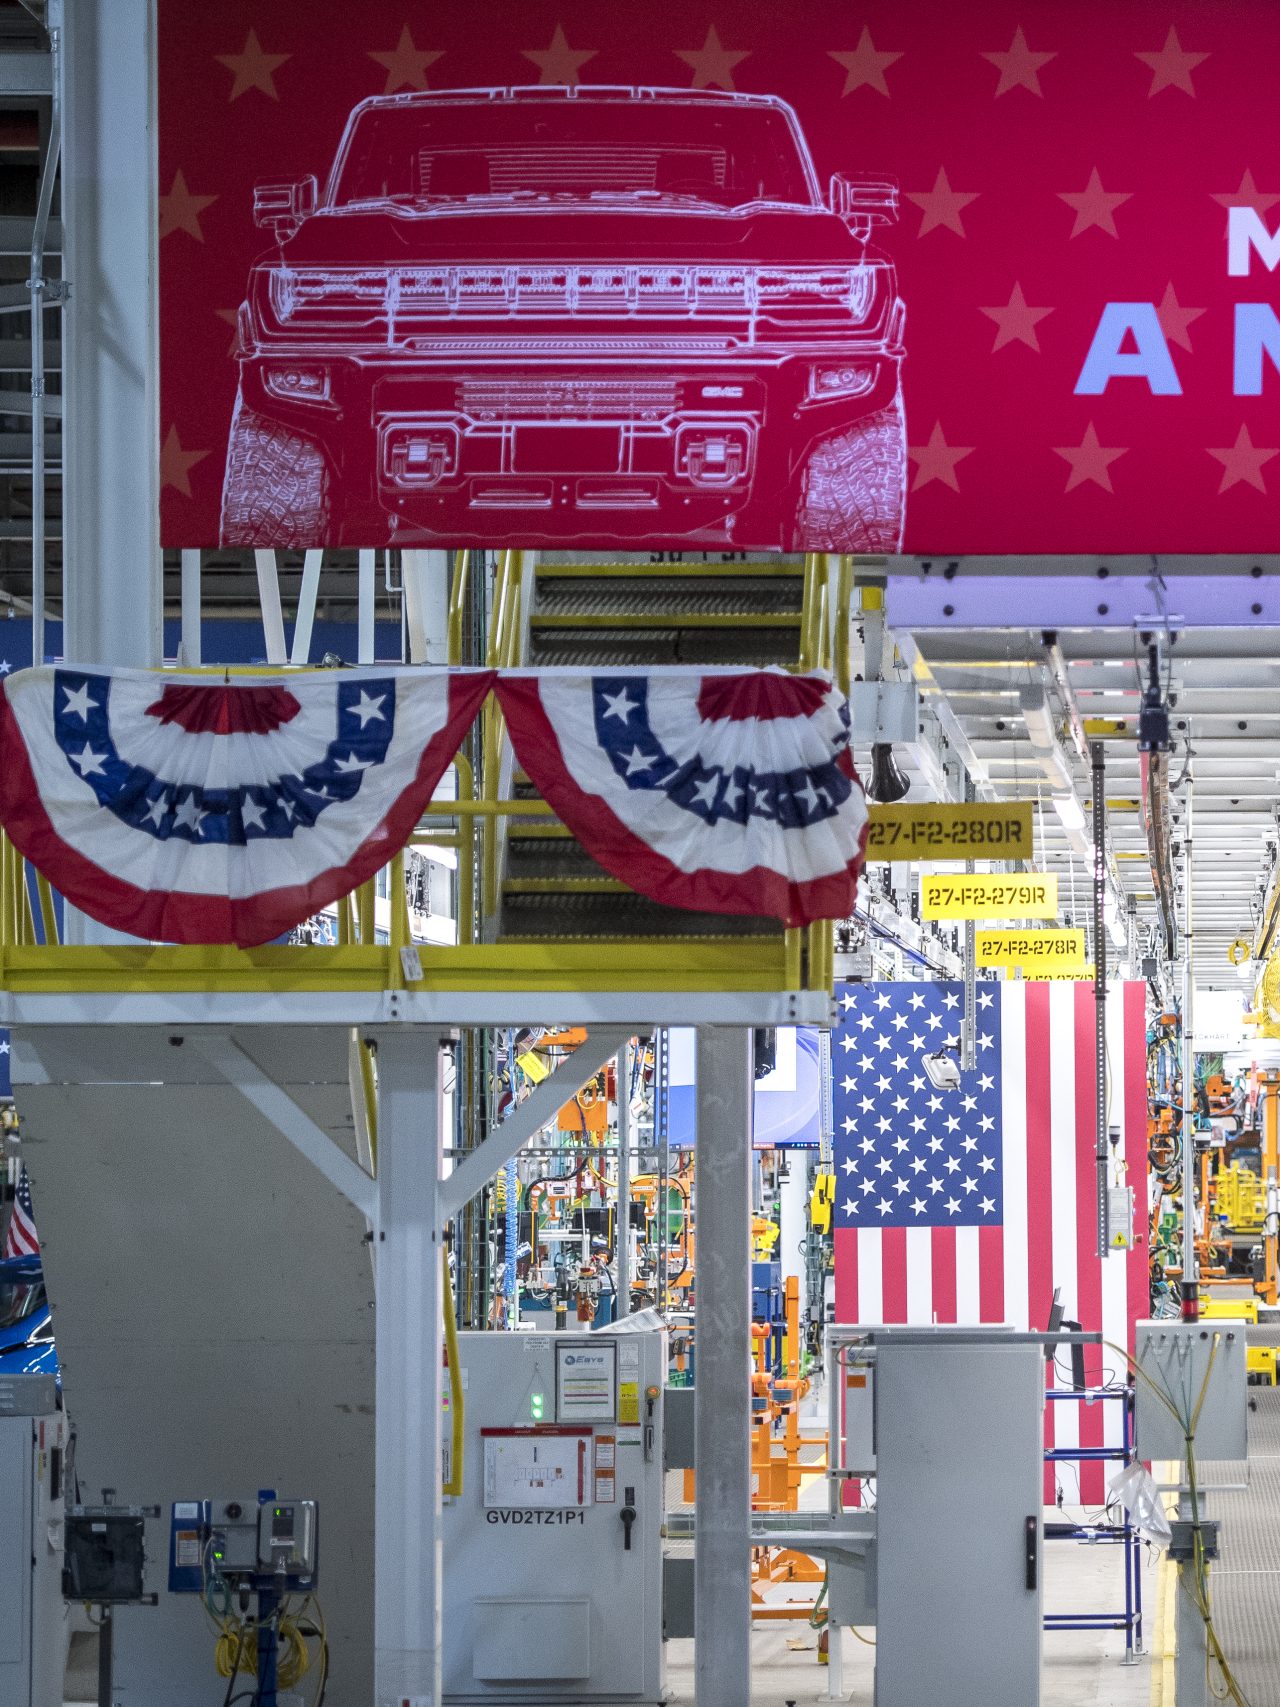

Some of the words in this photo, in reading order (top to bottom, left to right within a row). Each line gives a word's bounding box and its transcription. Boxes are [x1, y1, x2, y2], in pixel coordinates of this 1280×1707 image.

[868, 820, 1023, 845] 27-F2-280R
[928, 886, 1046, 906] 27-F2-279R
[981, 940, 1078, 956] 27-F2-278R
[486, 1511, 585, 1525] GVD2TZ1P1
